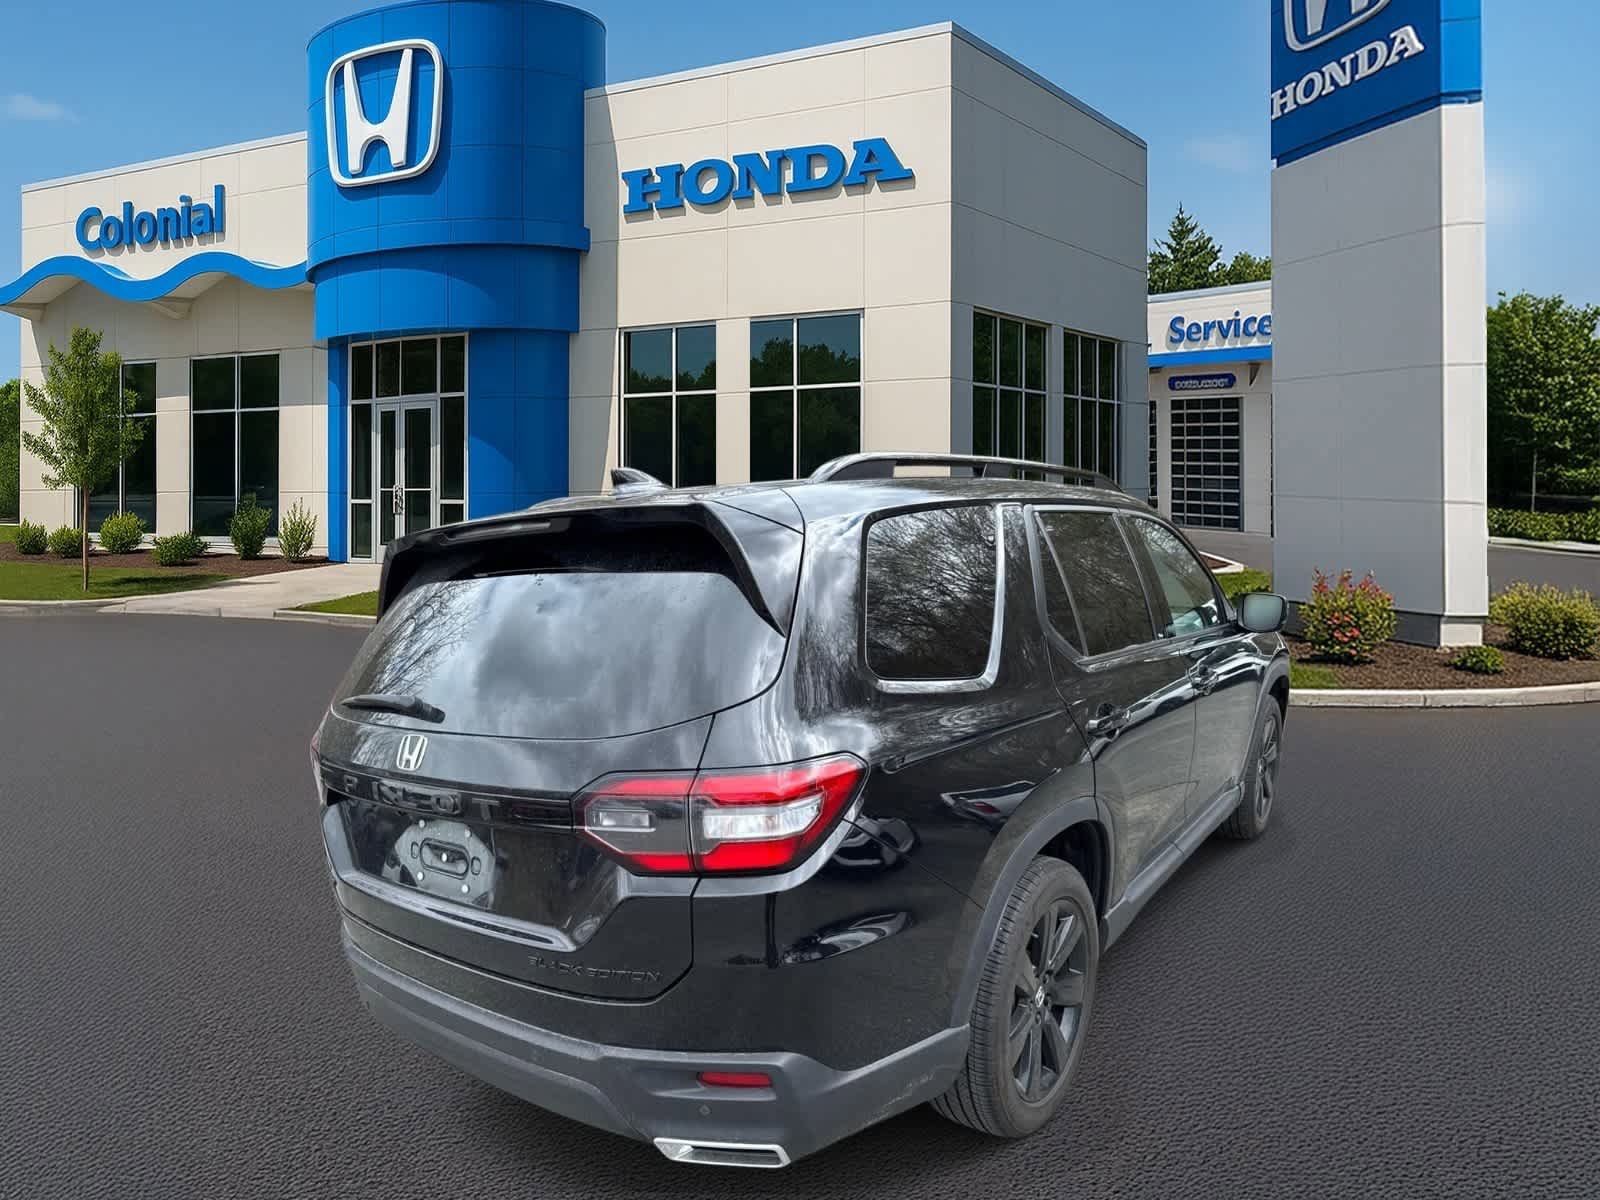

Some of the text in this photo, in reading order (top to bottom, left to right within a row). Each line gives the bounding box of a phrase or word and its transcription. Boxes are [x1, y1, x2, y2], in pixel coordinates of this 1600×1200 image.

[1271, 25, 1425, 120] HONDA
[621, 137, 914, 214] HONDA
[75, 184, 226, 251] Colonial
[1169, 310, 1272, 344] Service
[586, 966, 664, 985] EDITION
